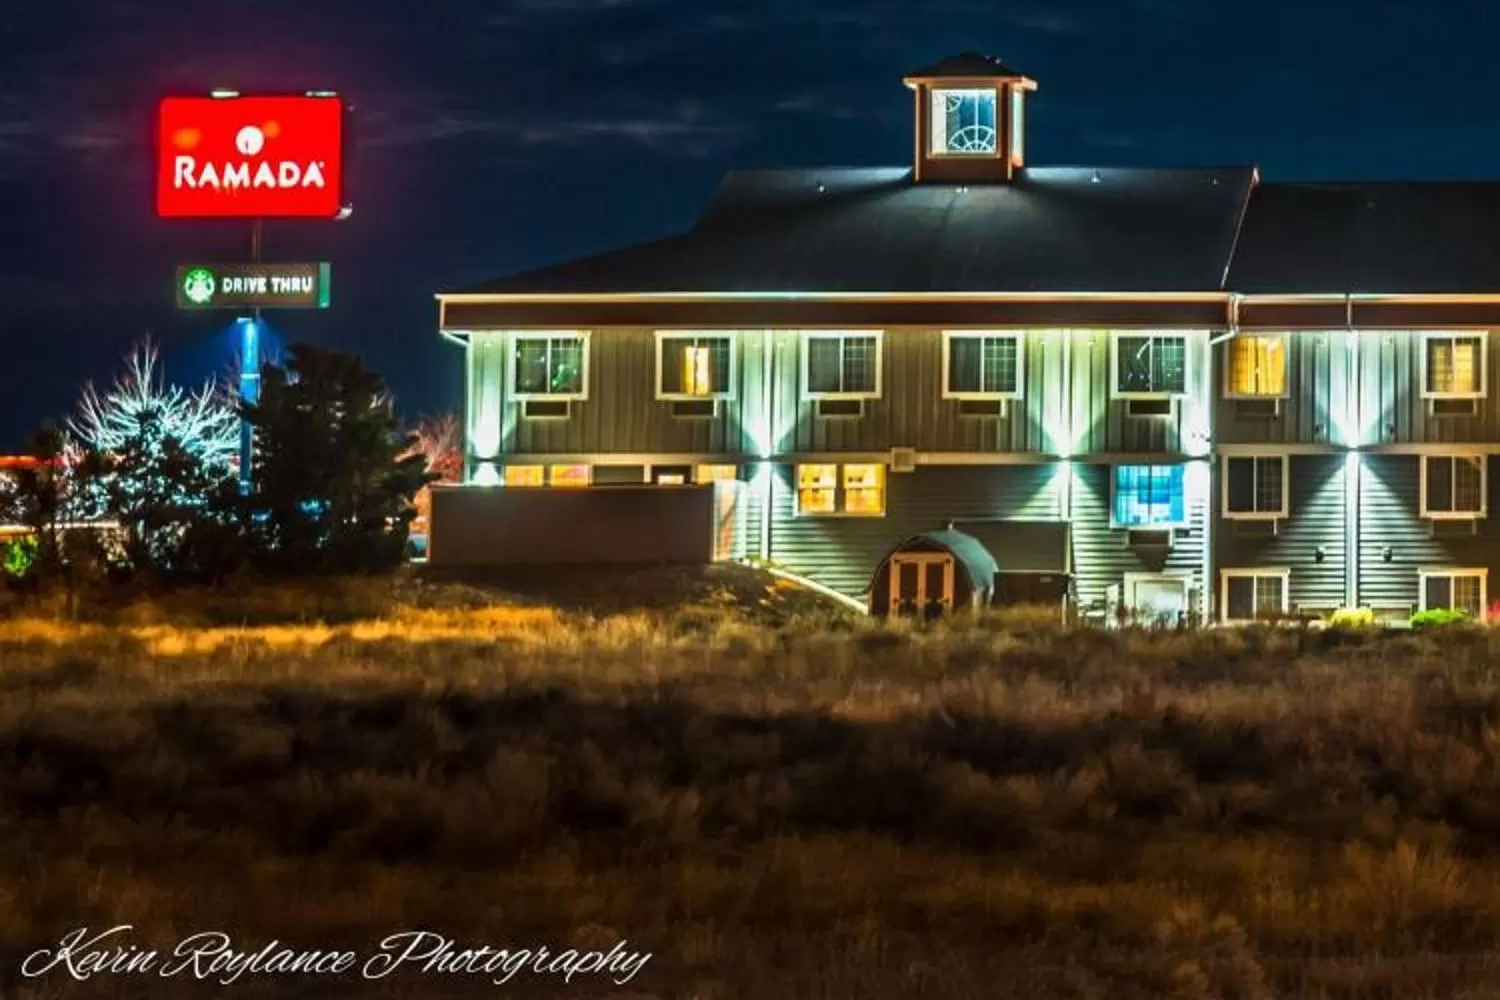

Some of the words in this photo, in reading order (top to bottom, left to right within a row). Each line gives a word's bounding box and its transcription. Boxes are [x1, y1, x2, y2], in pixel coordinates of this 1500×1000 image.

[174, 155, 325, 189] RAMADA
[222, 277, 267, 293] DRIVE
[270, 277, 313, 293] THRU
